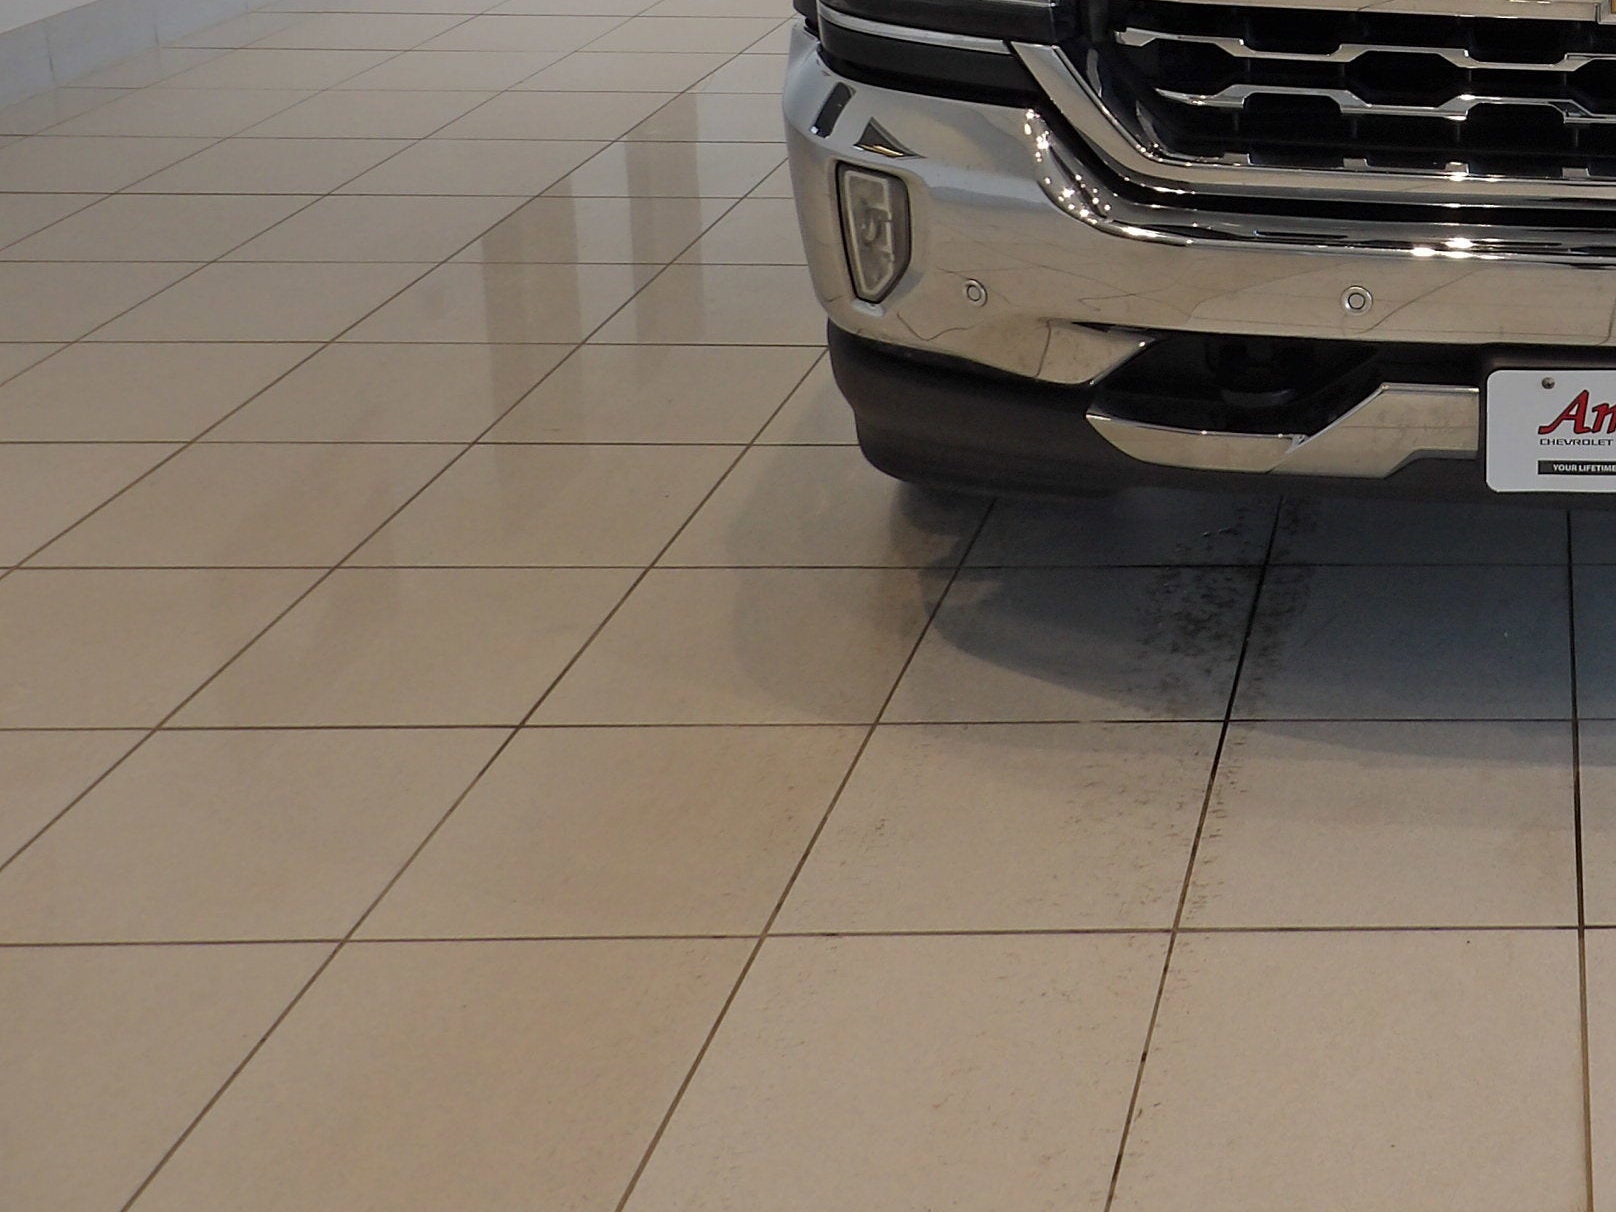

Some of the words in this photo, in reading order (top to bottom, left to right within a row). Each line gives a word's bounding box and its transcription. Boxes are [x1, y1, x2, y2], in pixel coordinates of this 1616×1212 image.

[1539, 438, 1614, 446] CHEVROLET
[1553, 464, 1577, 472] YOUR
[1579, 464, 1616, 472] LIFETIME
